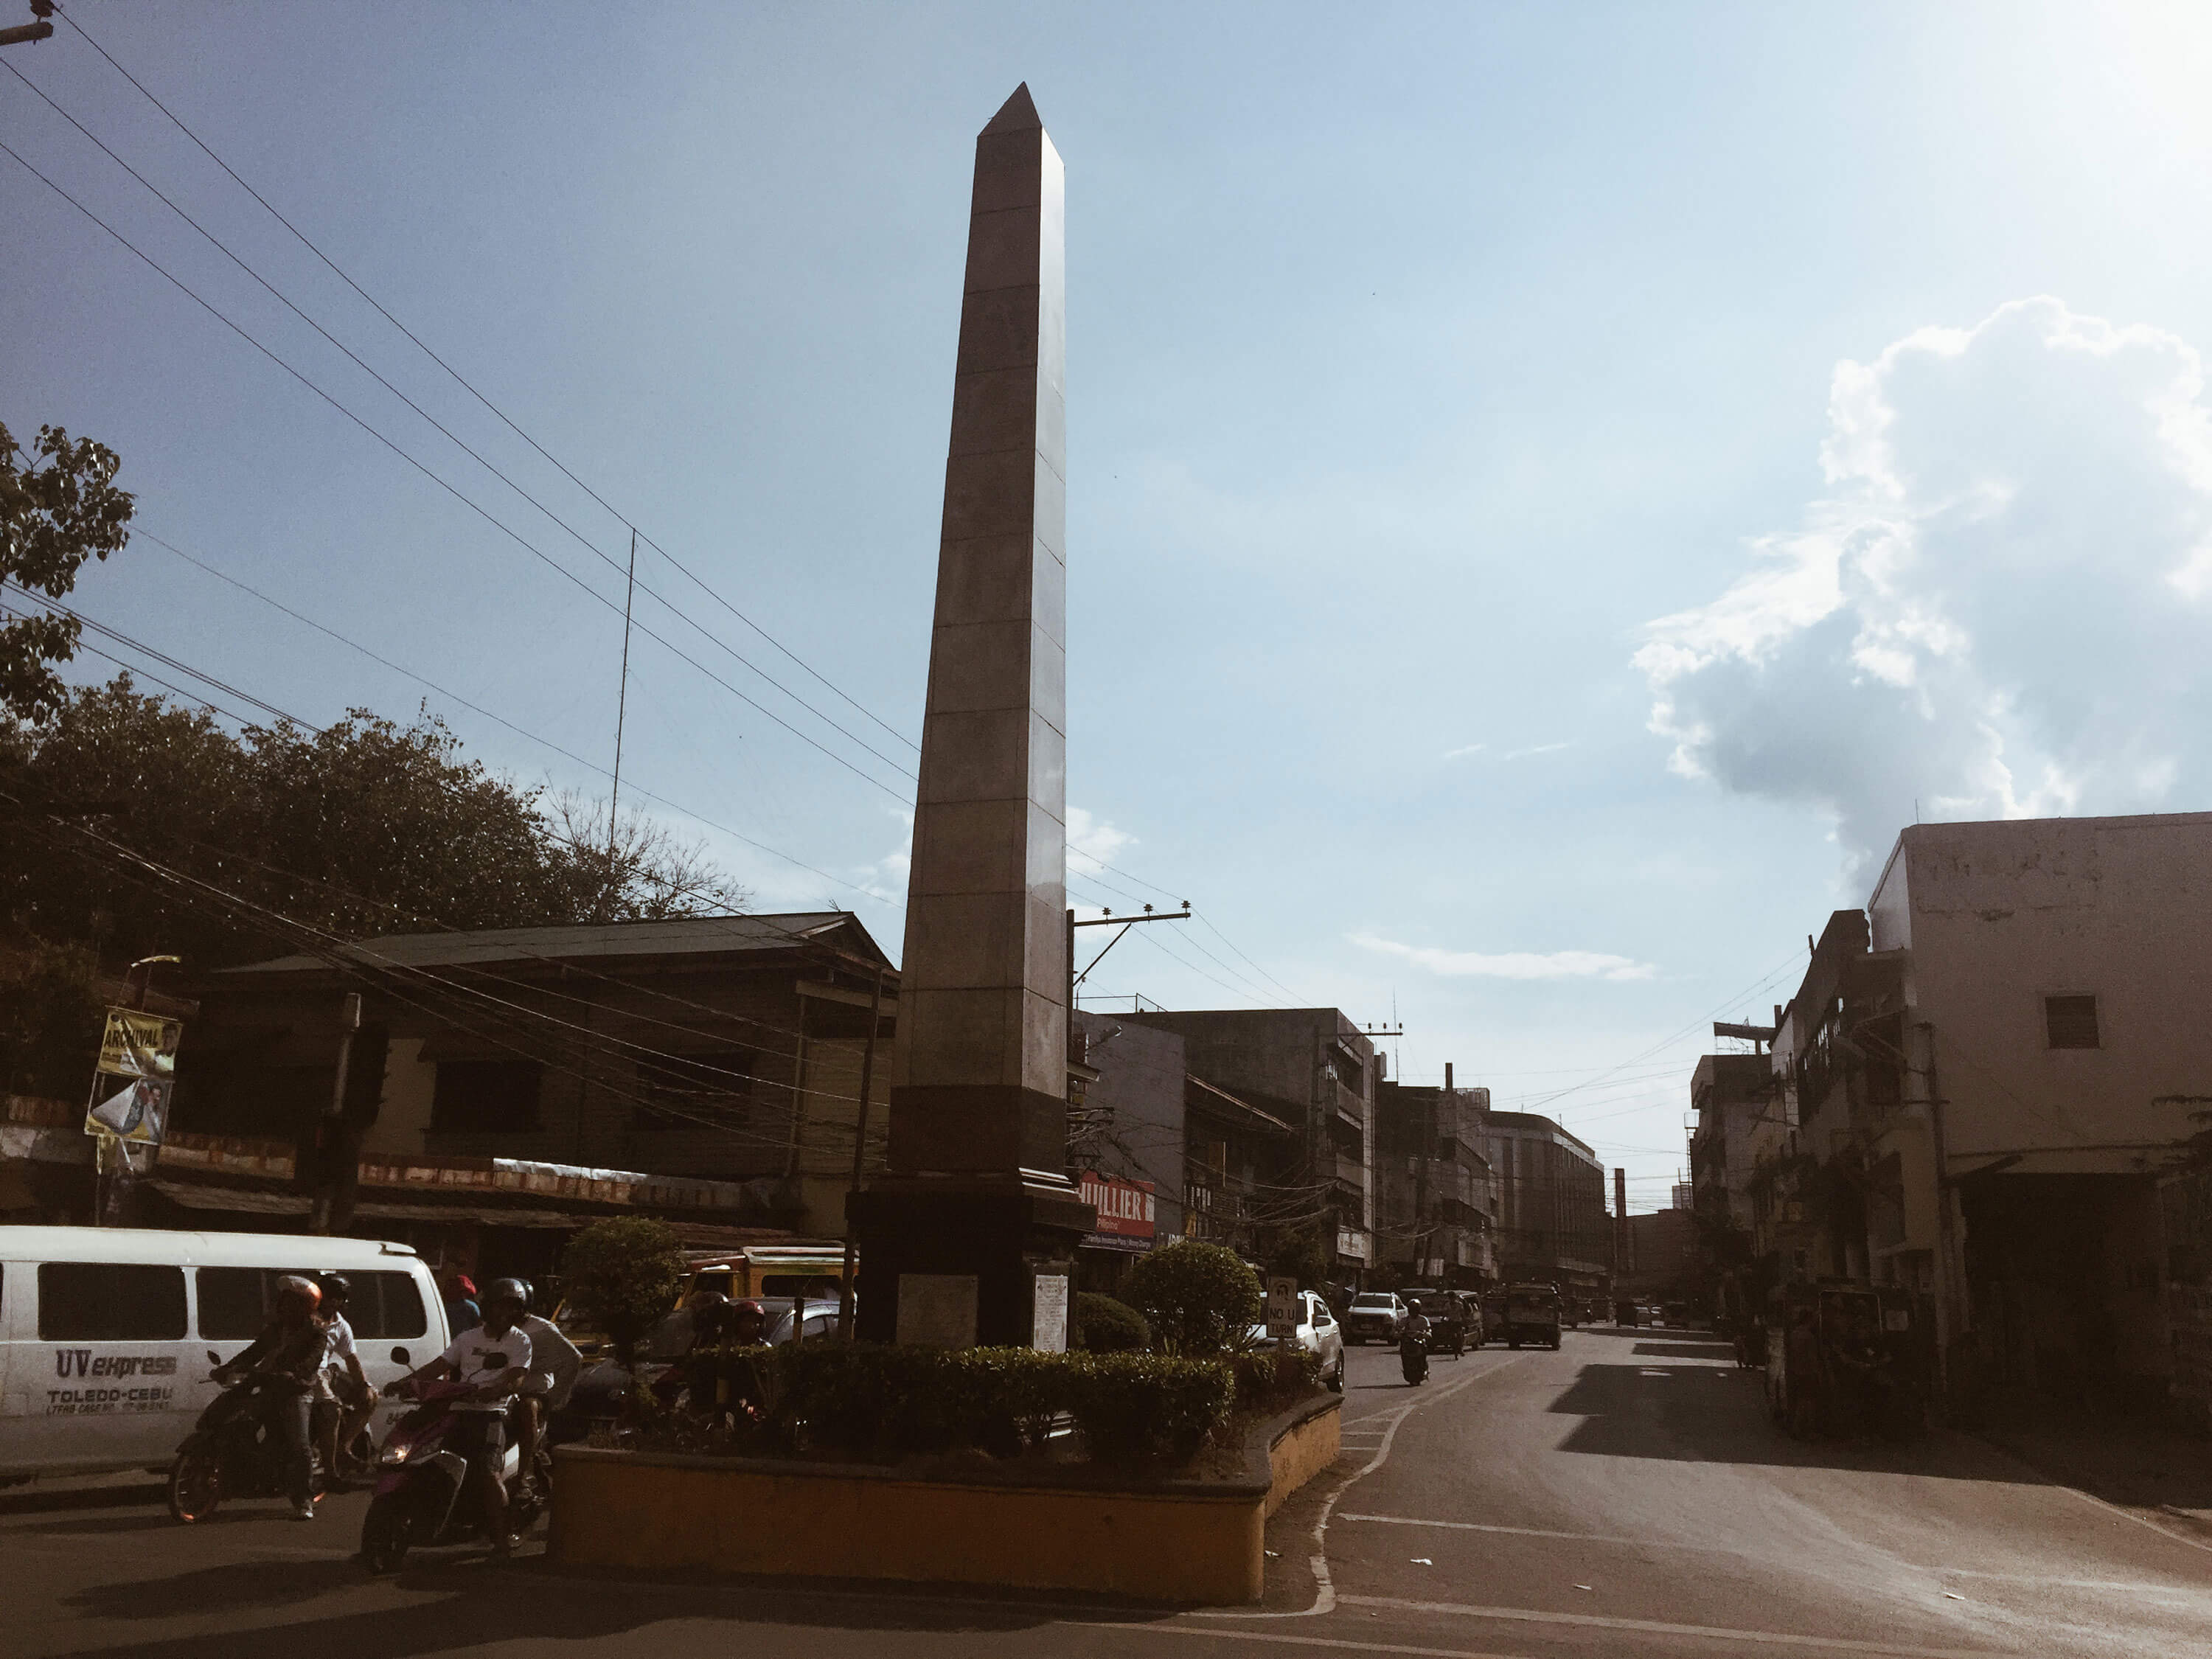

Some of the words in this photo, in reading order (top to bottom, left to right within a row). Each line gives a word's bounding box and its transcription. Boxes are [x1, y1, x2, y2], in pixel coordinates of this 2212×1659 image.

[1270, 1308, 1284, 1320] NO
[1287, 1309, 1295, 1321] U
[1271, 1324, 1293, 1334] TURN
[56, 1349, 91, 1378] UV
